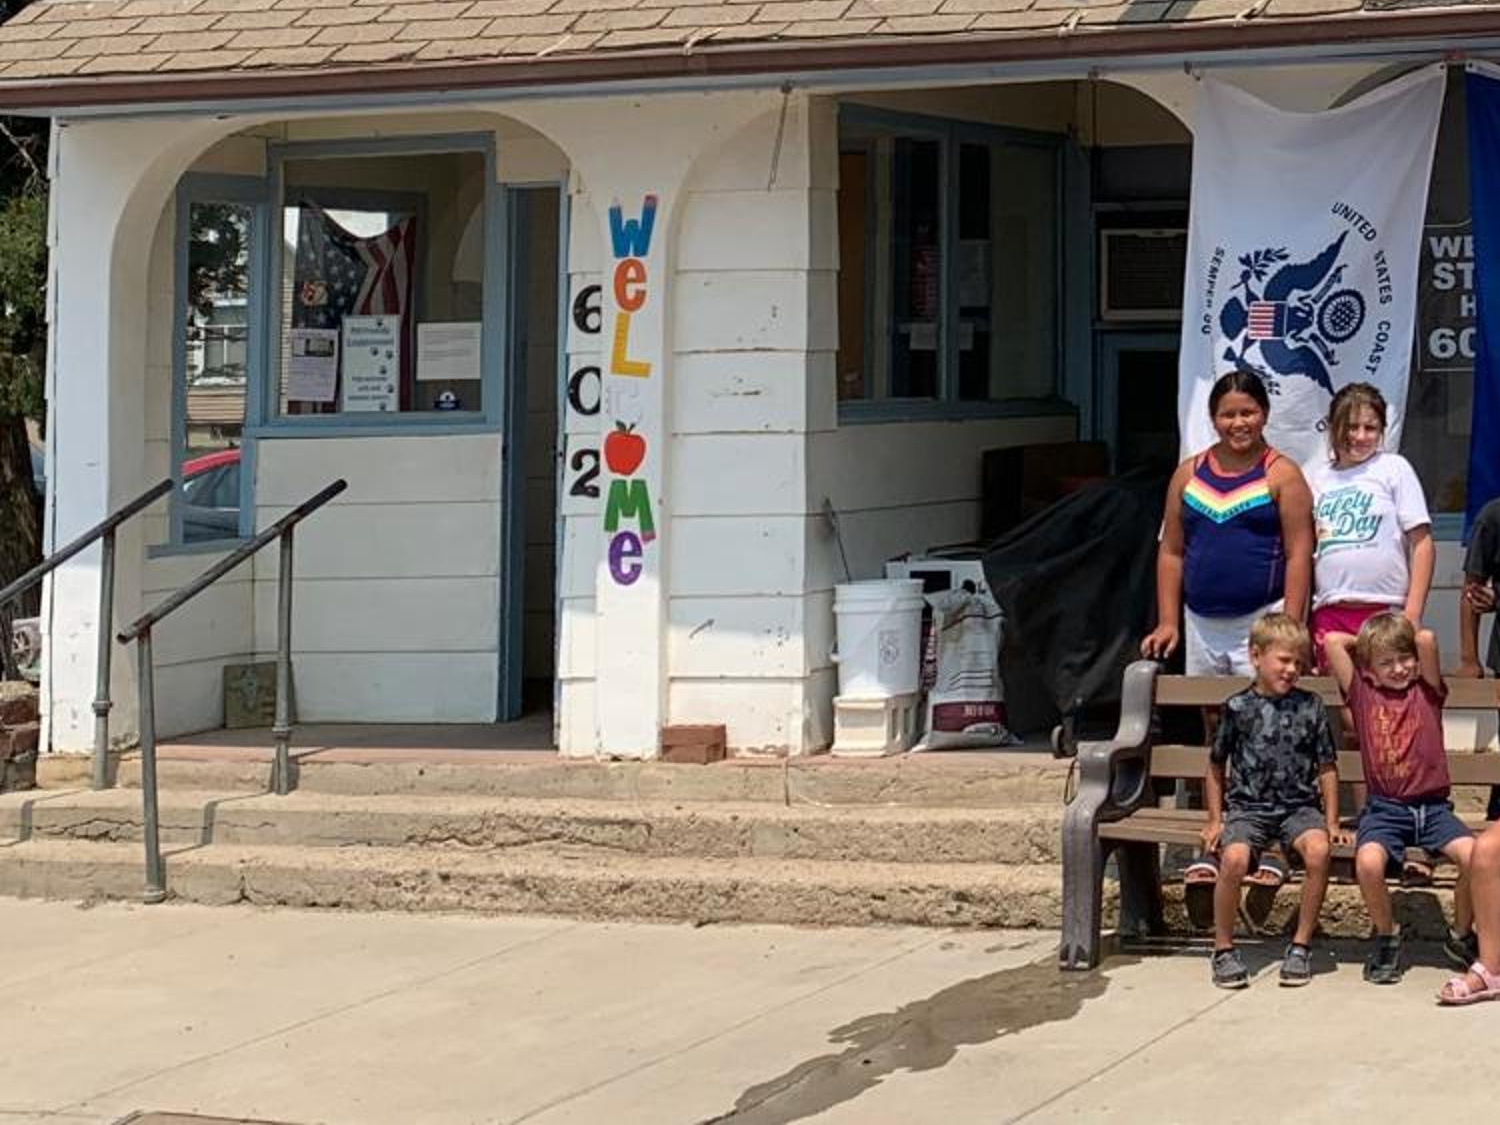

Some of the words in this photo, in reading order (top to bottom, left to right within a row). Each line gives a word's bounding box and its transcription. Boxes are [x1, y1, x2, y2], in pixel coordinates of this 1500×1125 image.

[1331, 202, 1378, 243] UNITED
[1372, 250, 1393, 305] STATES
[1364, 320, 1391, 375] COAST
